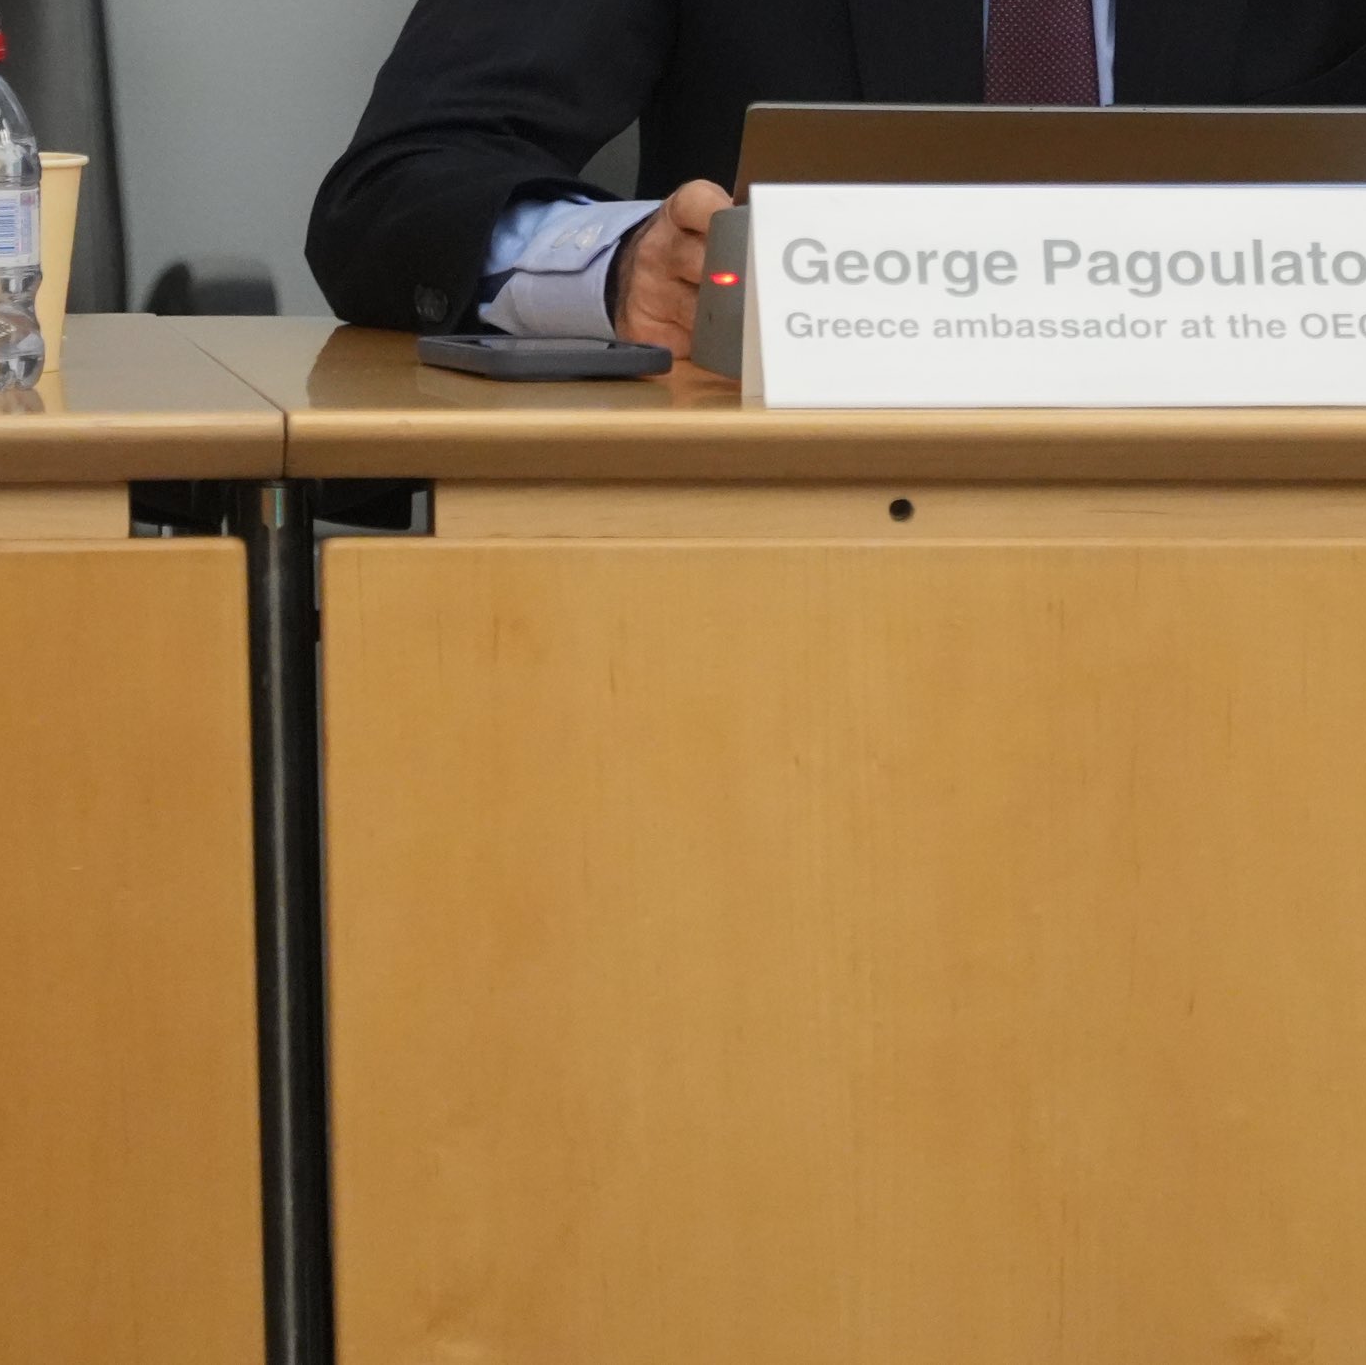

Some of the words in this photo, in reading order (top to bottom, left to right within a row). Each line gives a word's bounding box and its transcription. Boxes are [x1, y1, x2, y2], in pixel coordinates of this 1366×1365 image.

[781, 238, 1018, 298] George
[784, 311, 920, 339] Greece
[933, 312, 1168, 339] ambassador
[1180, 314, 1216, 339] at
[1226, 313, 1287, 340] the
